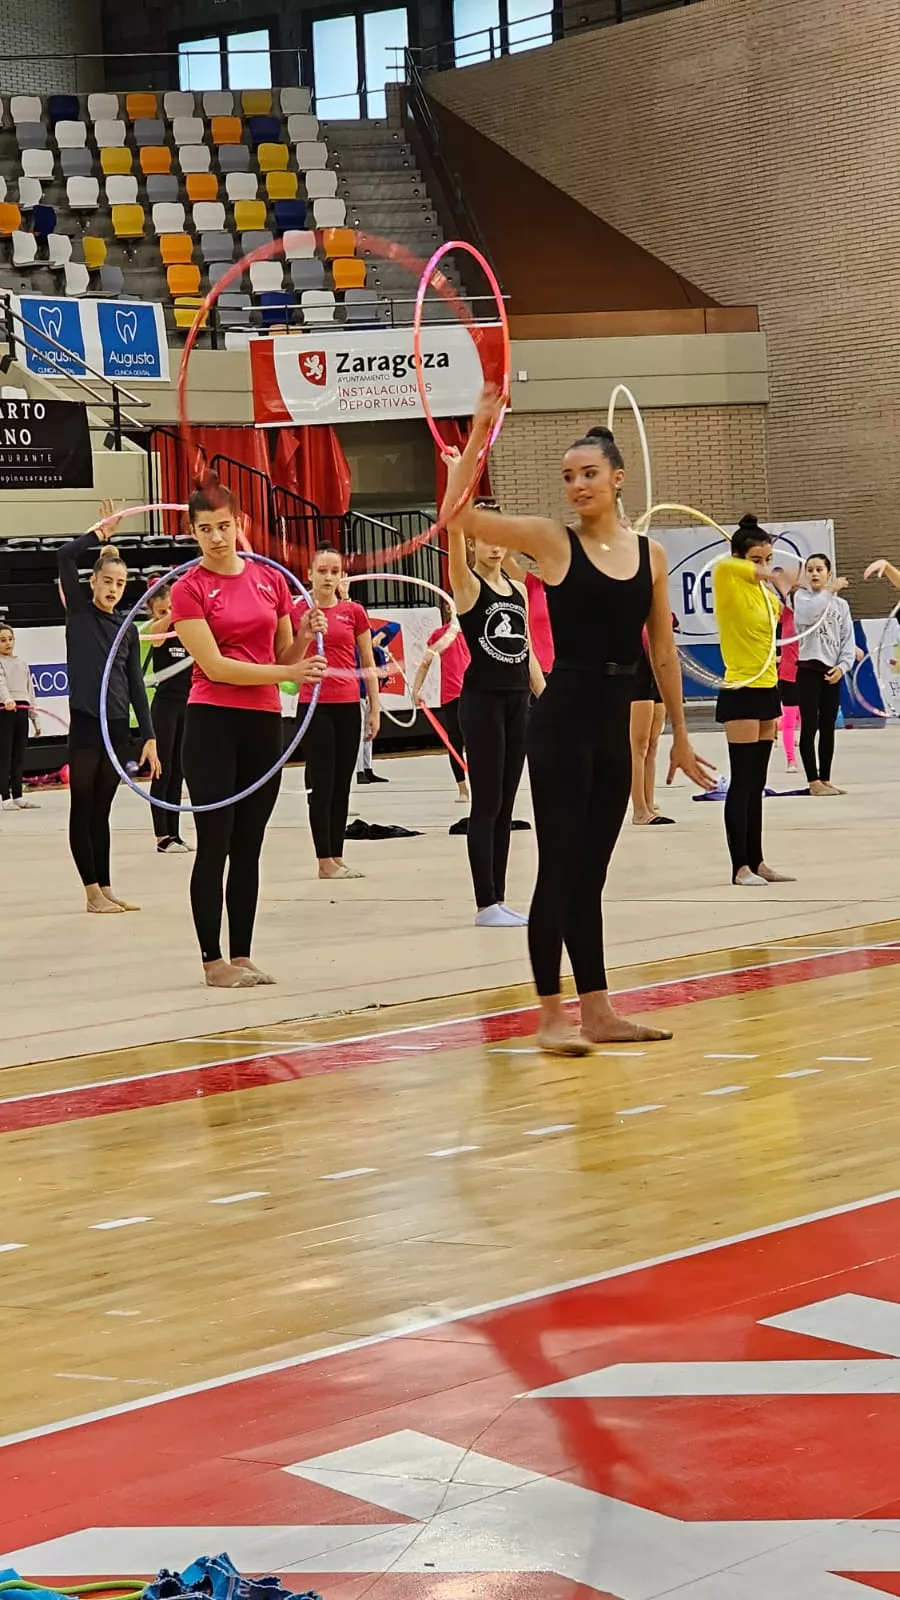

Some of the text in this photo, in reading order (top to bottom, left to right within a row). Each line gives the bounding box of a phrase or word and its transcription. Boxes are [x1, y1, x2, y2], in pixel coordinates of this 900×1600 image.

[109, 350, 155, 367] Augusta
[336, 352, 450, 378] Zaragoza
[337, 374, 390, 383] AYUNTAMIENTO
[338, 382, 432, 398] INSTALACIONS
[339, 396, 417, 411] DEPORTIVAS
